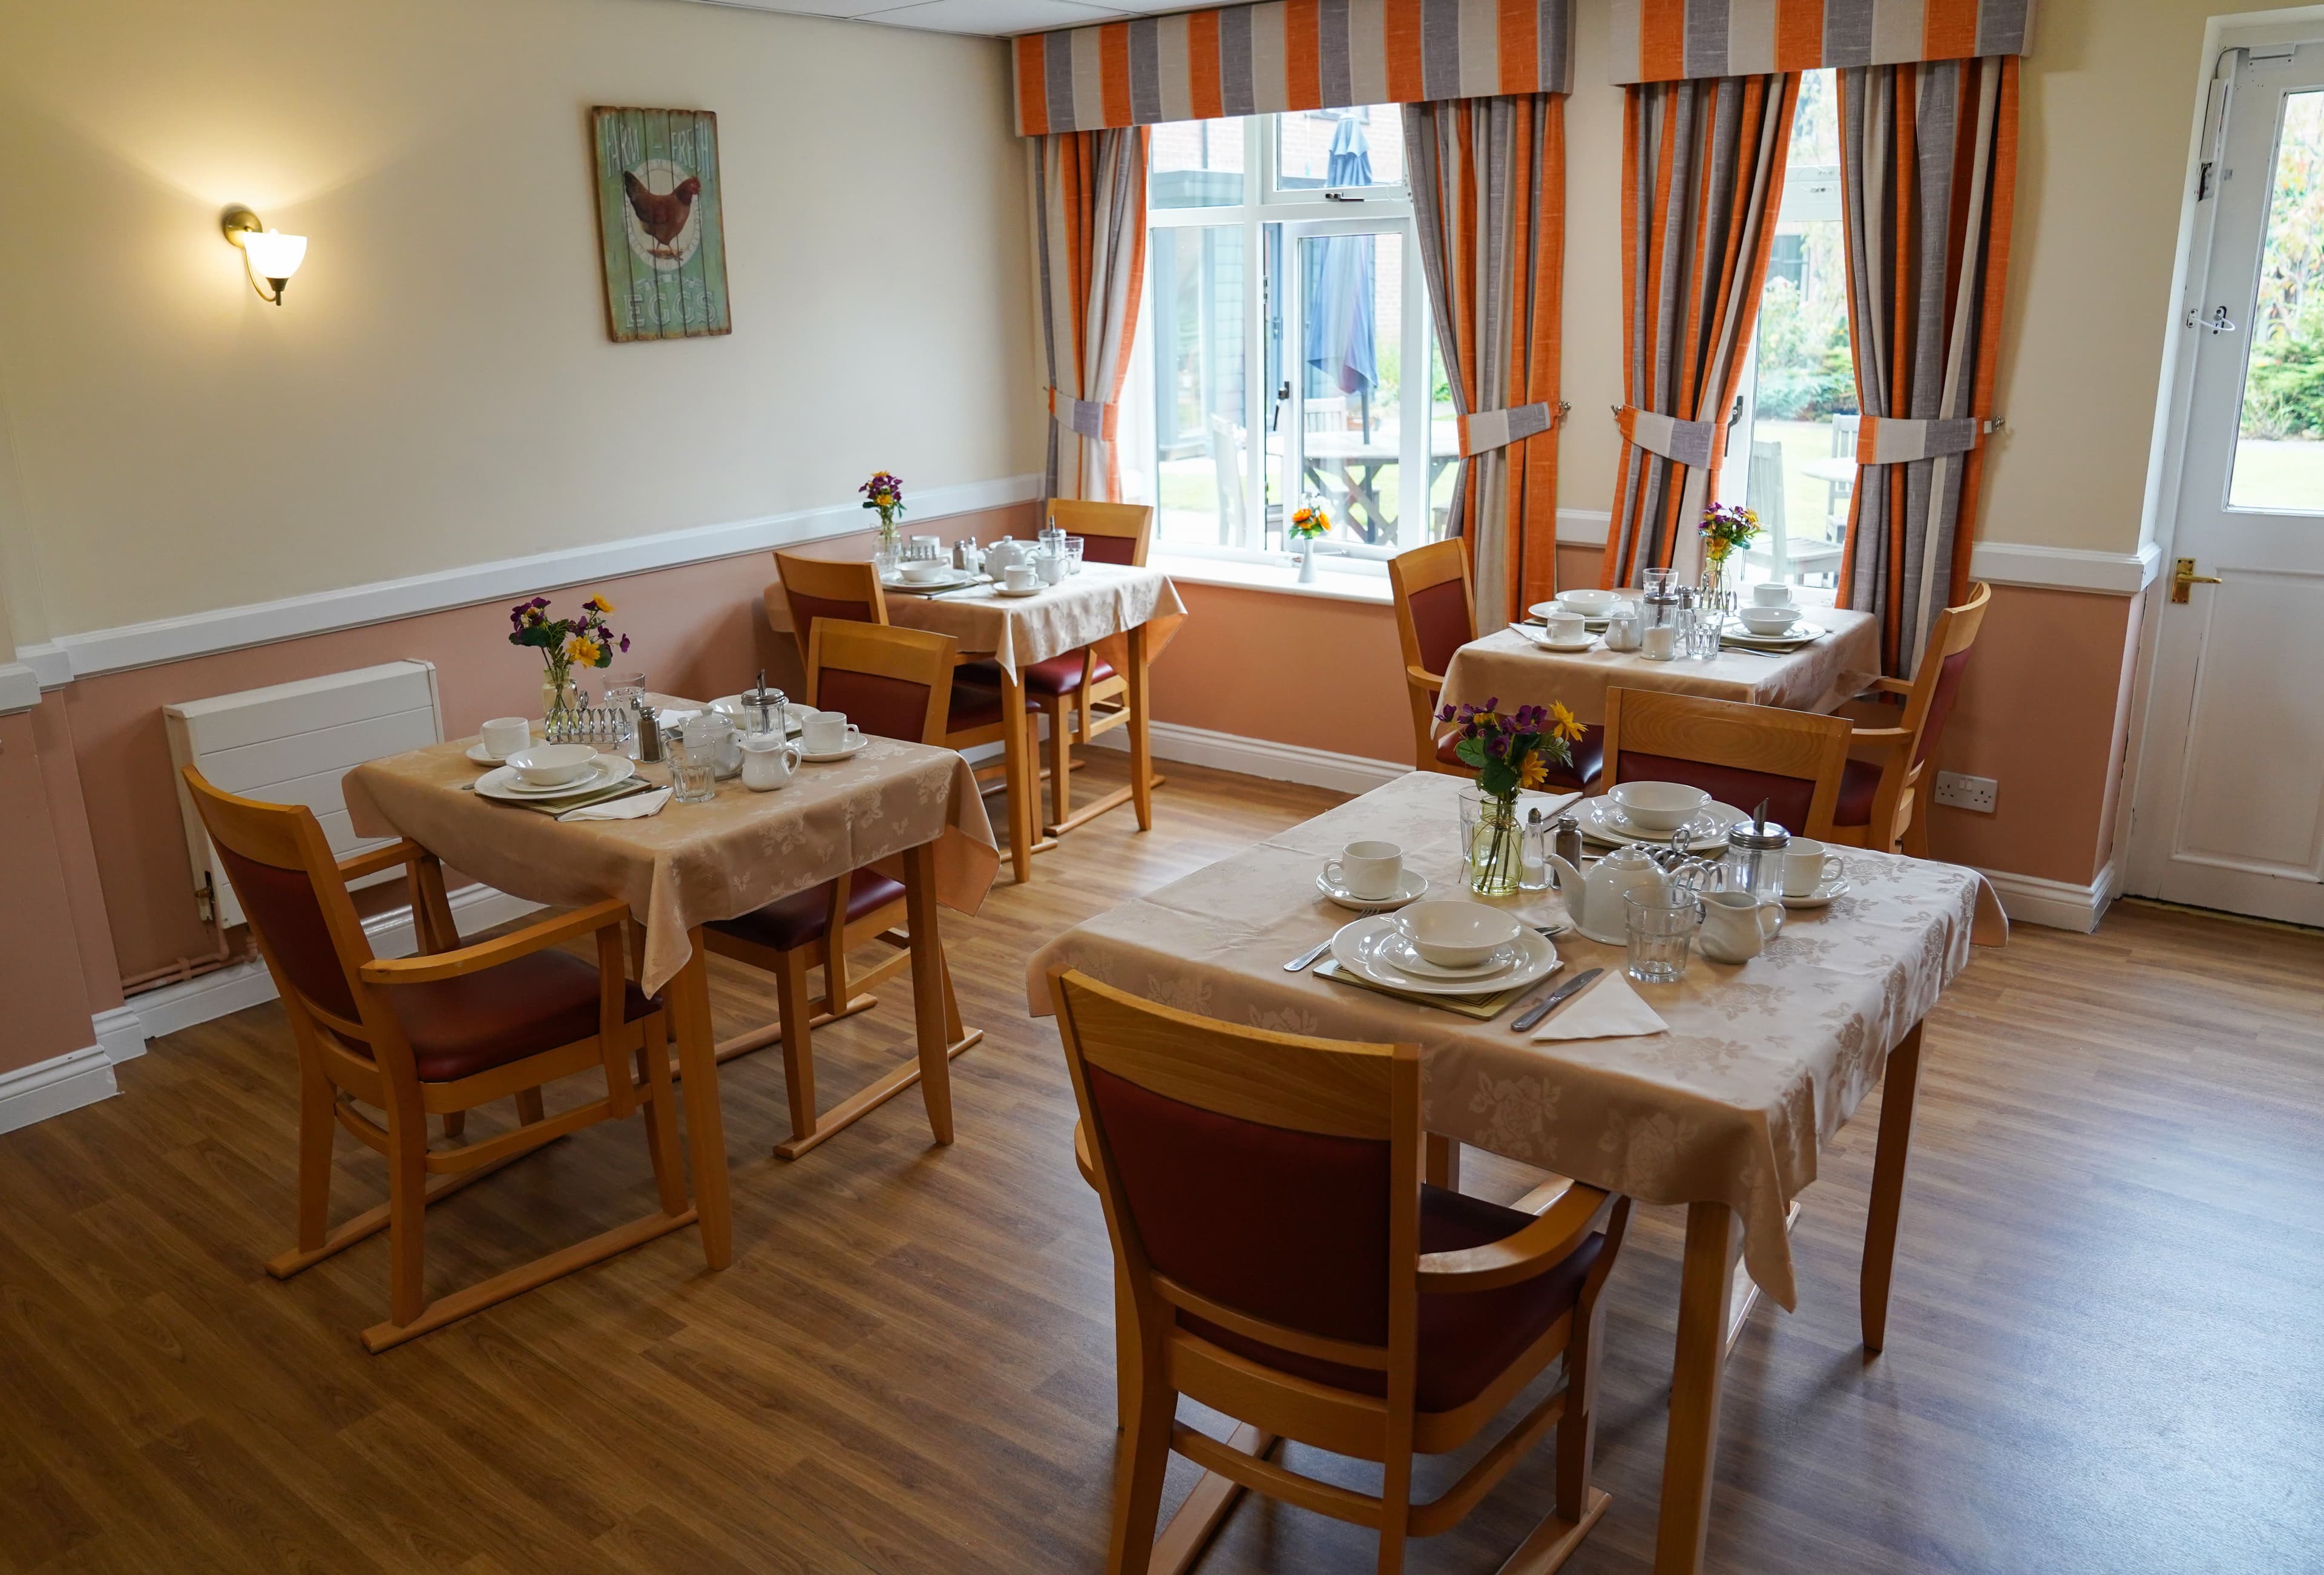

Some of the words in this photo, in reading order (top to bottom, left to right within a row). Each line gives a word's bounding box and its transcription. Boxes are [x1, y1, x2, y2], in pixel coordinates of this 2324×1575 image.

[605, 116, 640, 178] FARM
[671, 119, 712, 181] FRESH
[623, 291, 717, 329] EGGS
